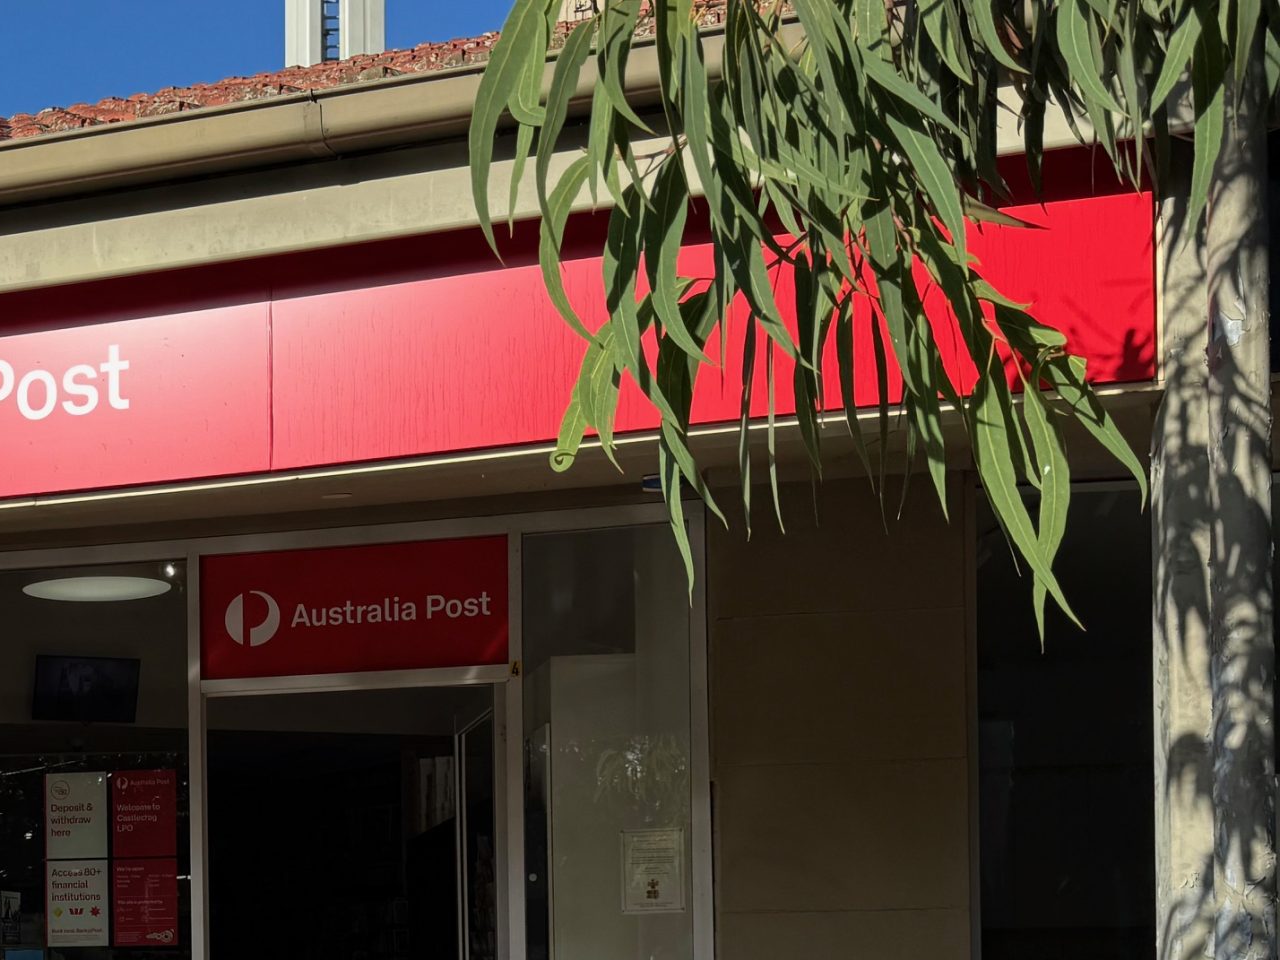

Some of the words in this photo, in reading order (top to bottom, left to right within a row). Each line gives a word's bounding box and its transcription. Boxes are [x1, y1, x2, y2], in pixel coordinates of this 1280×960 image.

[291, 596, 417, 628] Australia
[426, 591, 491, 619] Post
[50, 803, 85, 814] Deposit
[86, 802, 93, 811] &
[116, 803, 151, 812] Welcome
[152, 802, 161, 810] to
[50, 814, 91, 825] withdraw
[51, 828, 71, 837] here
[52, 868, 83, 877] Access
[84, 867, 102, 877] 80+
[52, 880, 88, 889] financial
[52, 893, 101, 902] institutions
